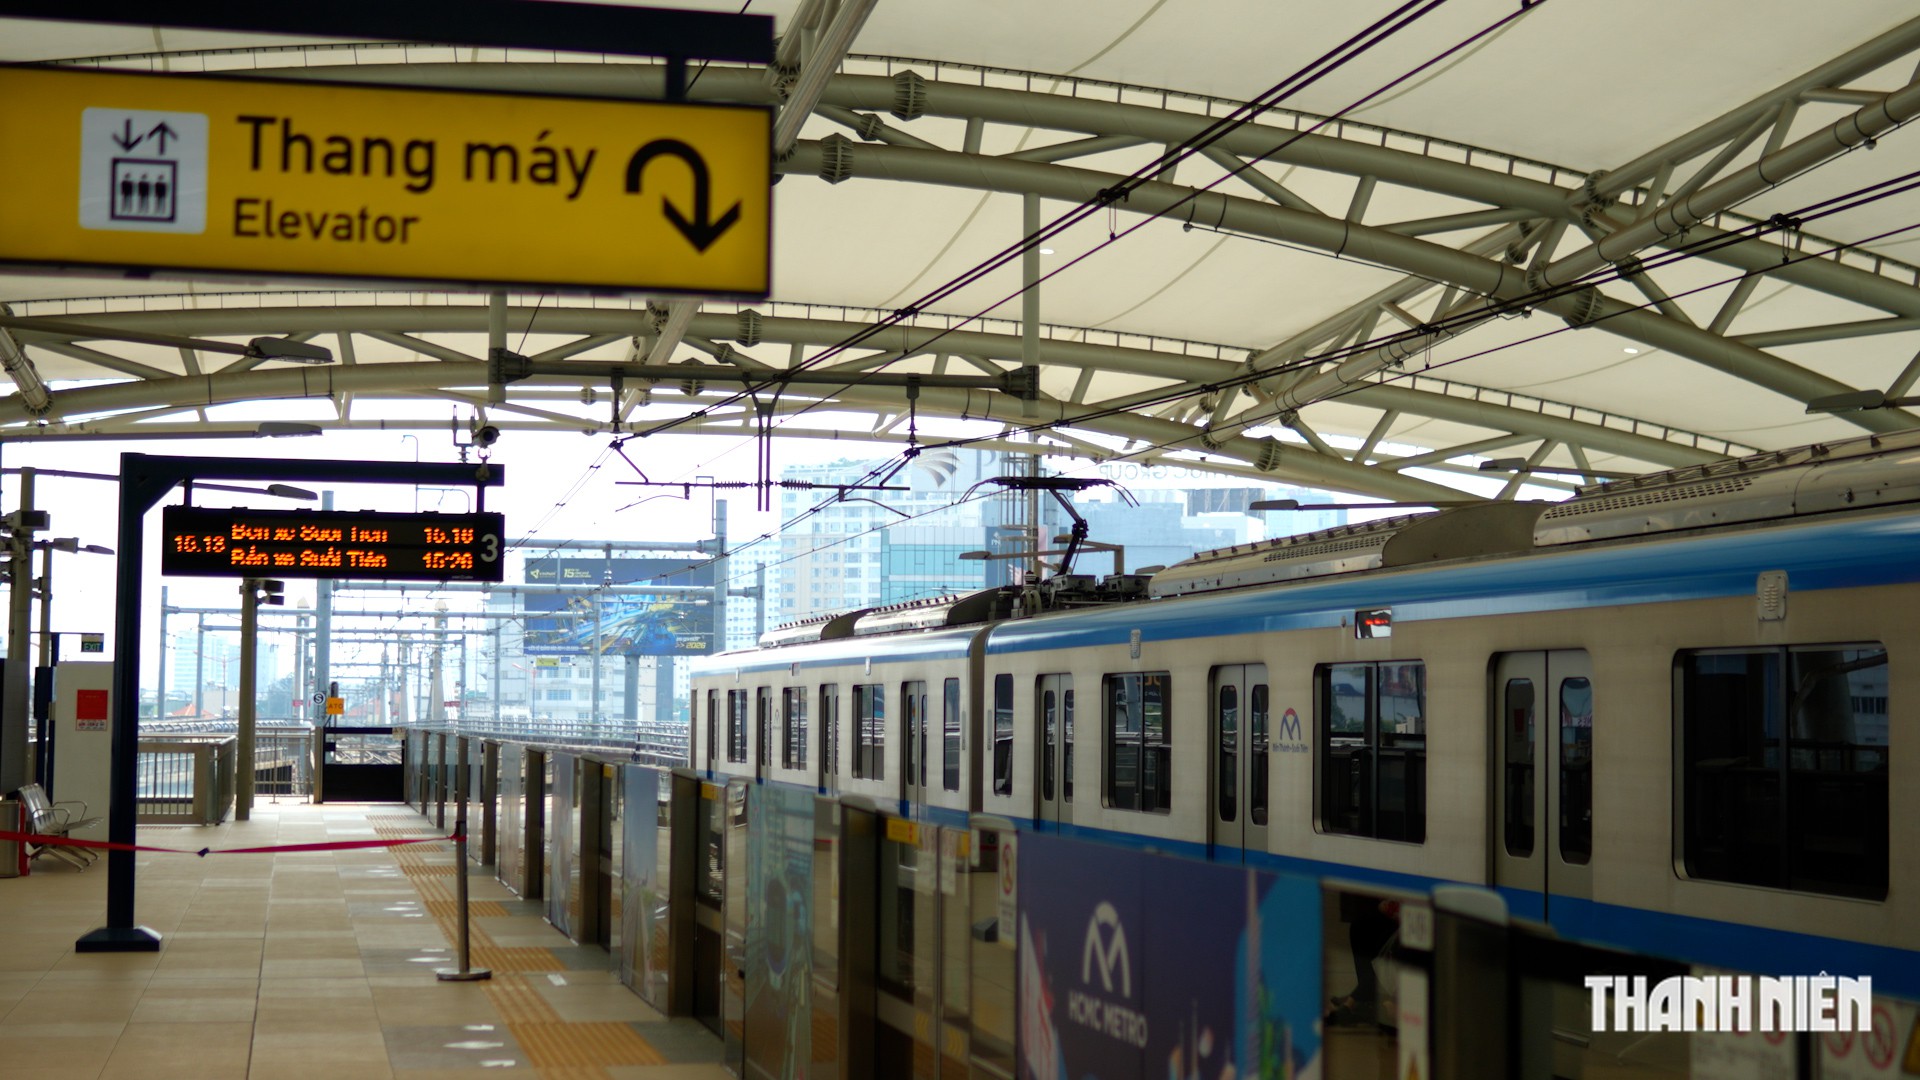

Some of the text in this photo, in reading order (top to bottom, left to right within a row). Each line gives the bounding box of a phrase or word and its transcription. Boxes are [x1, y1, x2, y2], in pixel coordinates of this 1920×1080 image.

[236, 114, 597, 200] Thang máy
[233, 197, 418, 243] Elevator
[482, 533, 498, 562] 3
[84, 642, 101, 652] EXIT
[1104, 1001, 1148, 1048] METRO
